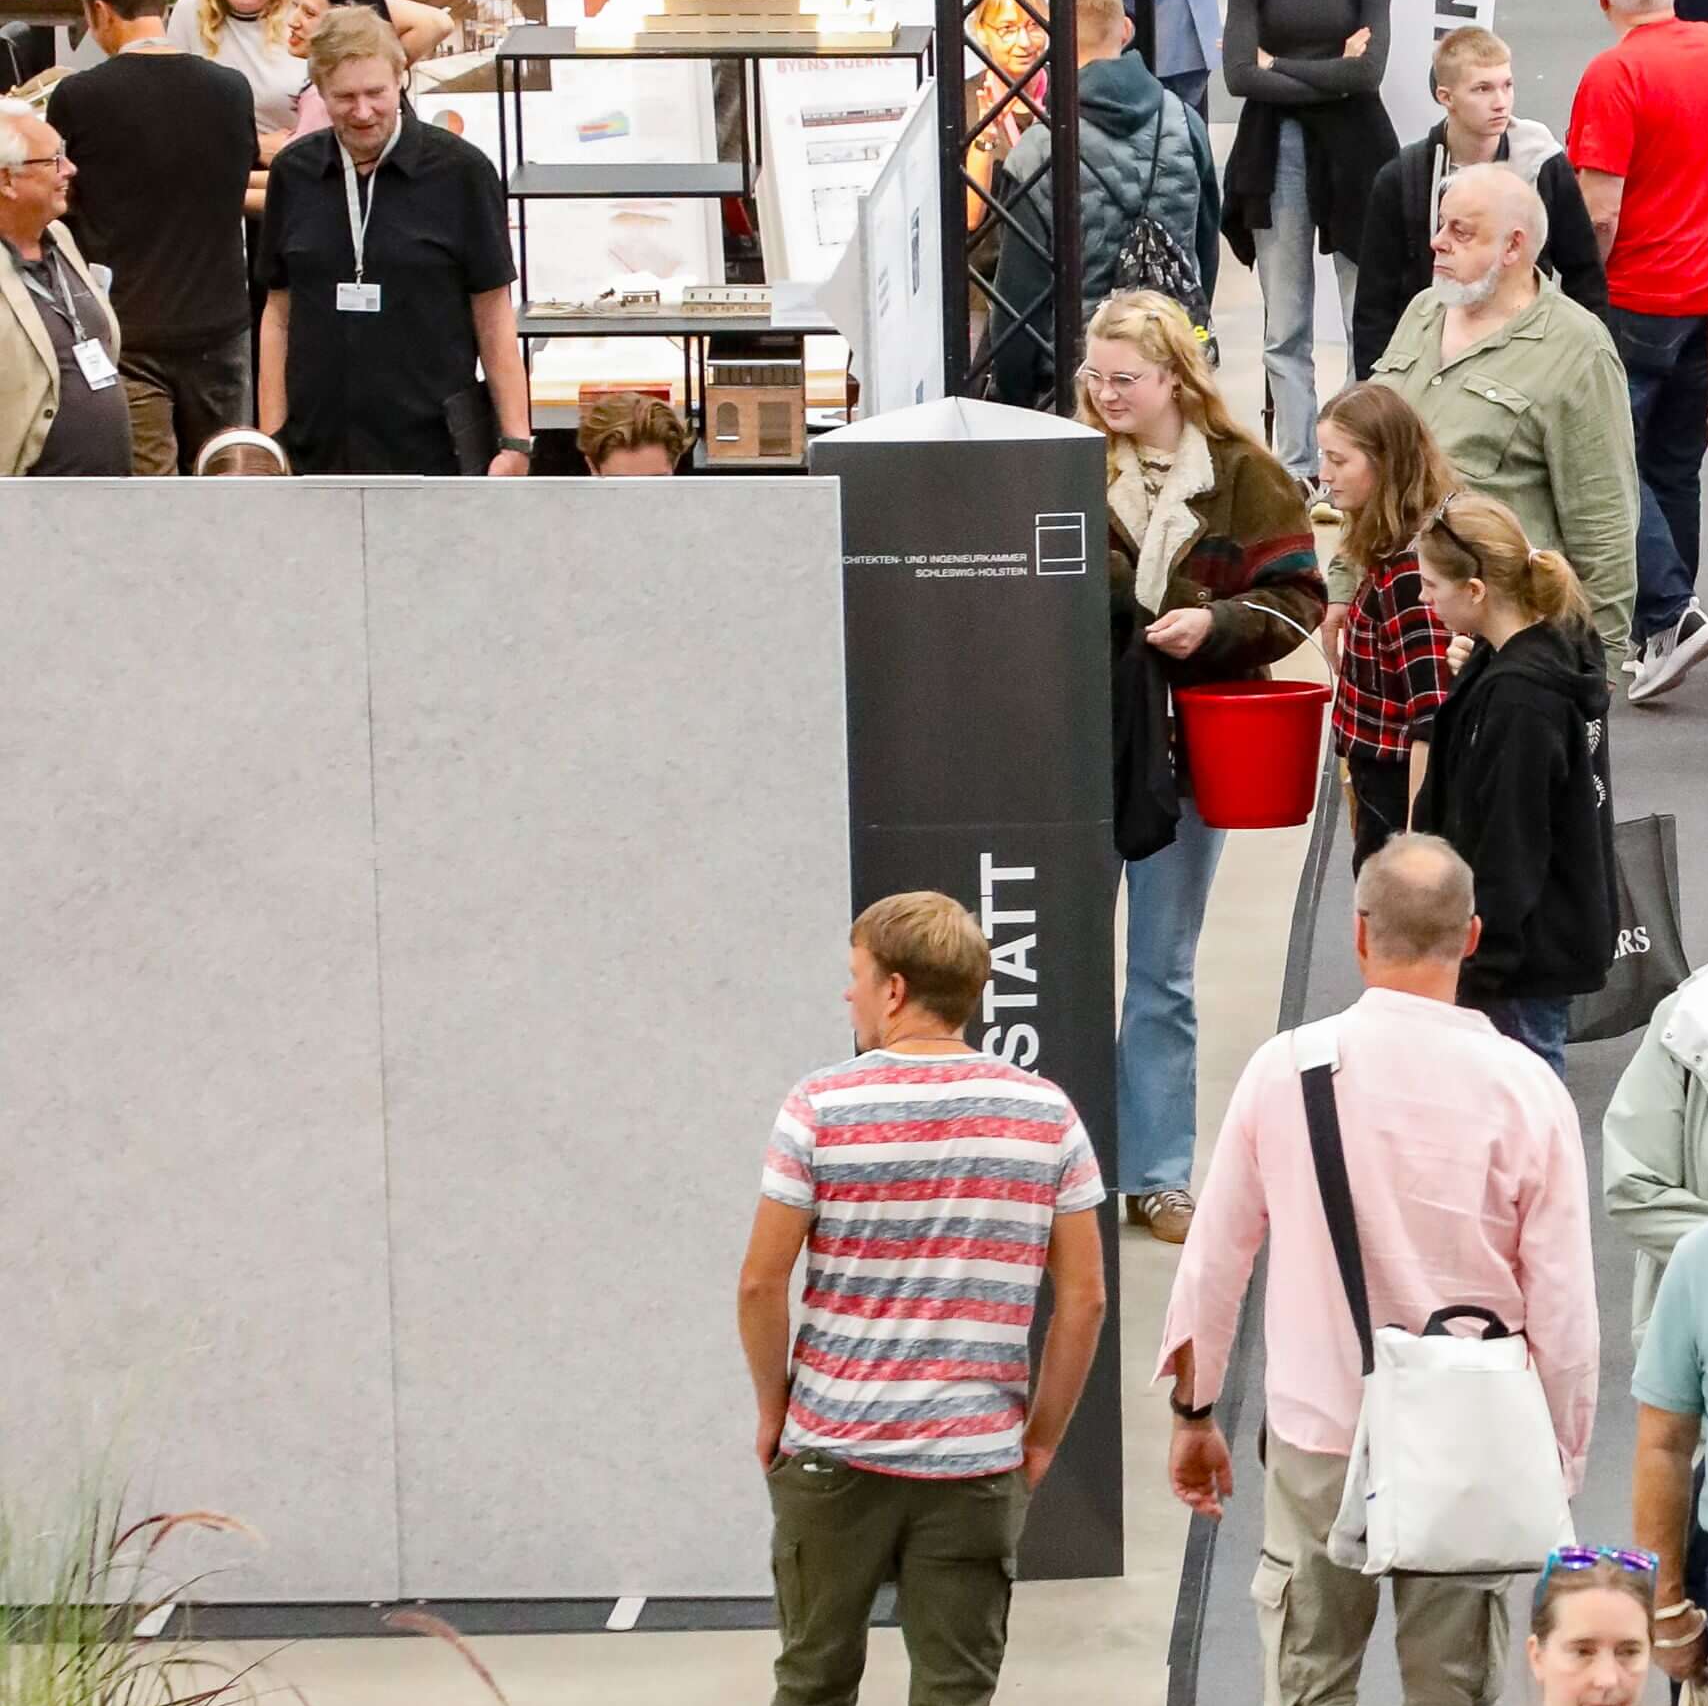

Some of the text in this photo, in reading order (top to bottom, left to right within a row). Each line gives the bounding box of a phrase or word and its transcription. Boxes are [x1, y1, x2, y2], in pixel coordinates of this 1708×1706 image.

[841, 552, 1029, 566] CHITEKTEN- UND INGENIEURKAMMER
[914, 566, 1029, 579] SCHLESWIG-HOLSTEIN
[980, 852, 1040, 1077] STATT
